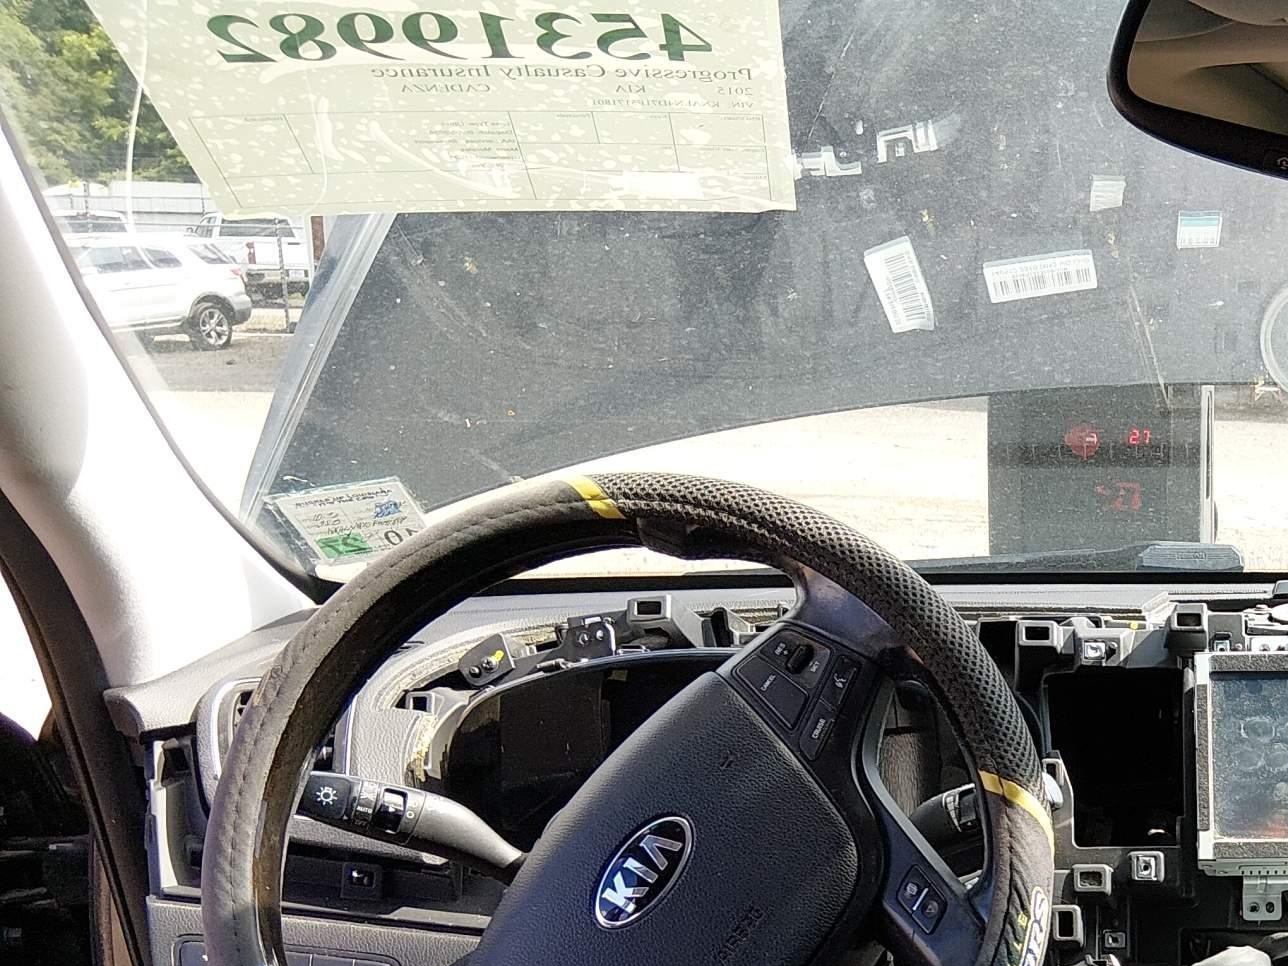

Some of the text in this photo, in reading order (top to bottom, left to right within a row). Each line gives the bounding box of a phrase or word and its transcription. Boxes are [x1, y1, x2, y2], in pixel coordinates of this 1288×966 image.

[760, 674, 776, 692] CANCEL
[811, 719, 826, 739] CRUISE
[356, 805, 373, 814] AUTO
[601, 834, 684, 915] KIA
